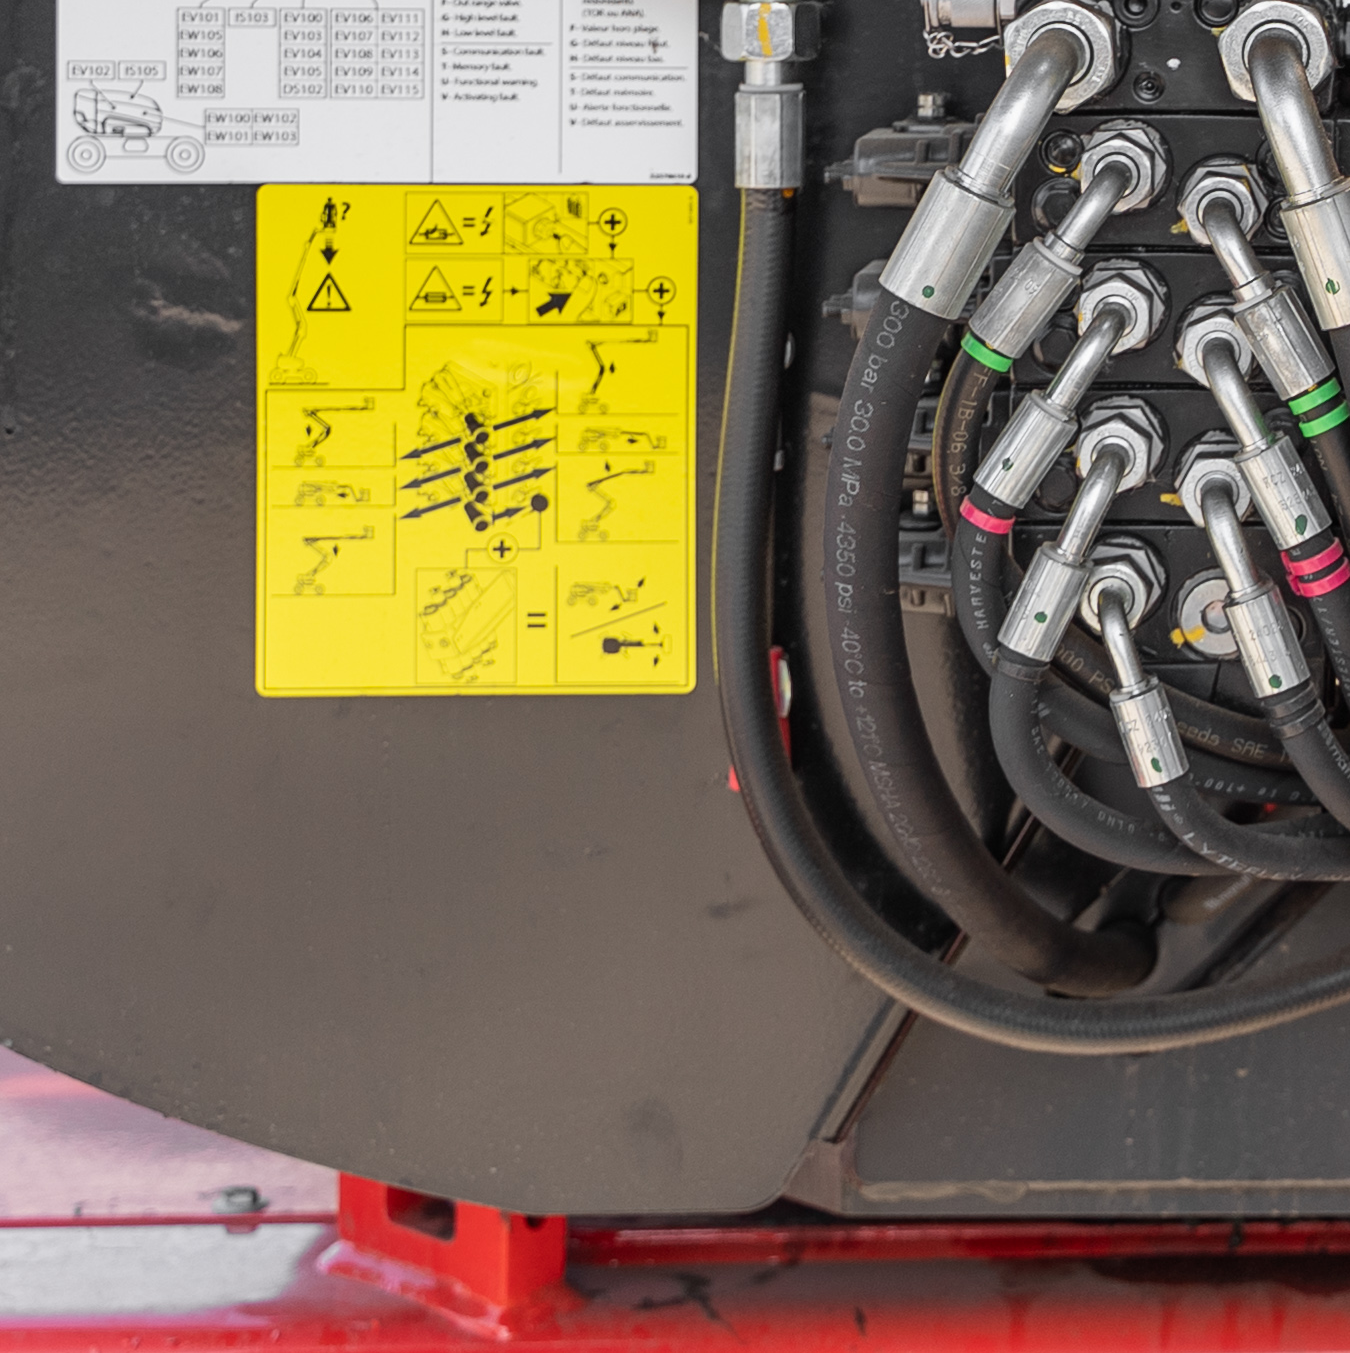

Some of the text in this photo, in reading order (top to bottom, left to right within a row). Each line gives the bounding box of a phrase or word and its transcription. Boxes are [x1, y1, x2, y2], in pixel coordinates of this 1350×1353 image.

[182, 12, 219, 22] EV101
[235, 12, 269, 23] IS103
[284, 12, 323, 22] EV100
[334, 12, 373, 22] EV106
[381, 12, 420, 22] EV111
[179, 30, 223, 40] EW105
[284, 30, 323, 40] EV103
[334, 30, 373, 40] EV107
[381, 30, 420, 40] EV112
[179, 48, 223, 58] EW106
[284, 48, 323, 58] EV104
[334, 48, 373, 58] EV108
[381, 48, 420, 58] EV113
[72, 66, 110, 76] EV102
[125, 65, 158, 76] IS105
[179, 66, 223, 76] EW107
[284, 66, 323, 76] EV105
[334, 66, 373, 76] EV109
[381, 66, 420, 76] EV114
[179, 84, 223, 94] EW108
[284, 84, 323, 94] DS102
[334, 84, 373, 94] EV110
[381, 84, 420, 94] EV115
[207, 113, 250, 123] EW100
[254, 113, 297, 124] EW102
[207, 131, 249, 141] EW101
[254, 132, 297, 142] EW103
[860, 352, 888, 394] bar
[846, 399, 874, 452] 30.0
[837, 455, 863, 507] MPa
[848, 680, 868, 698] to
